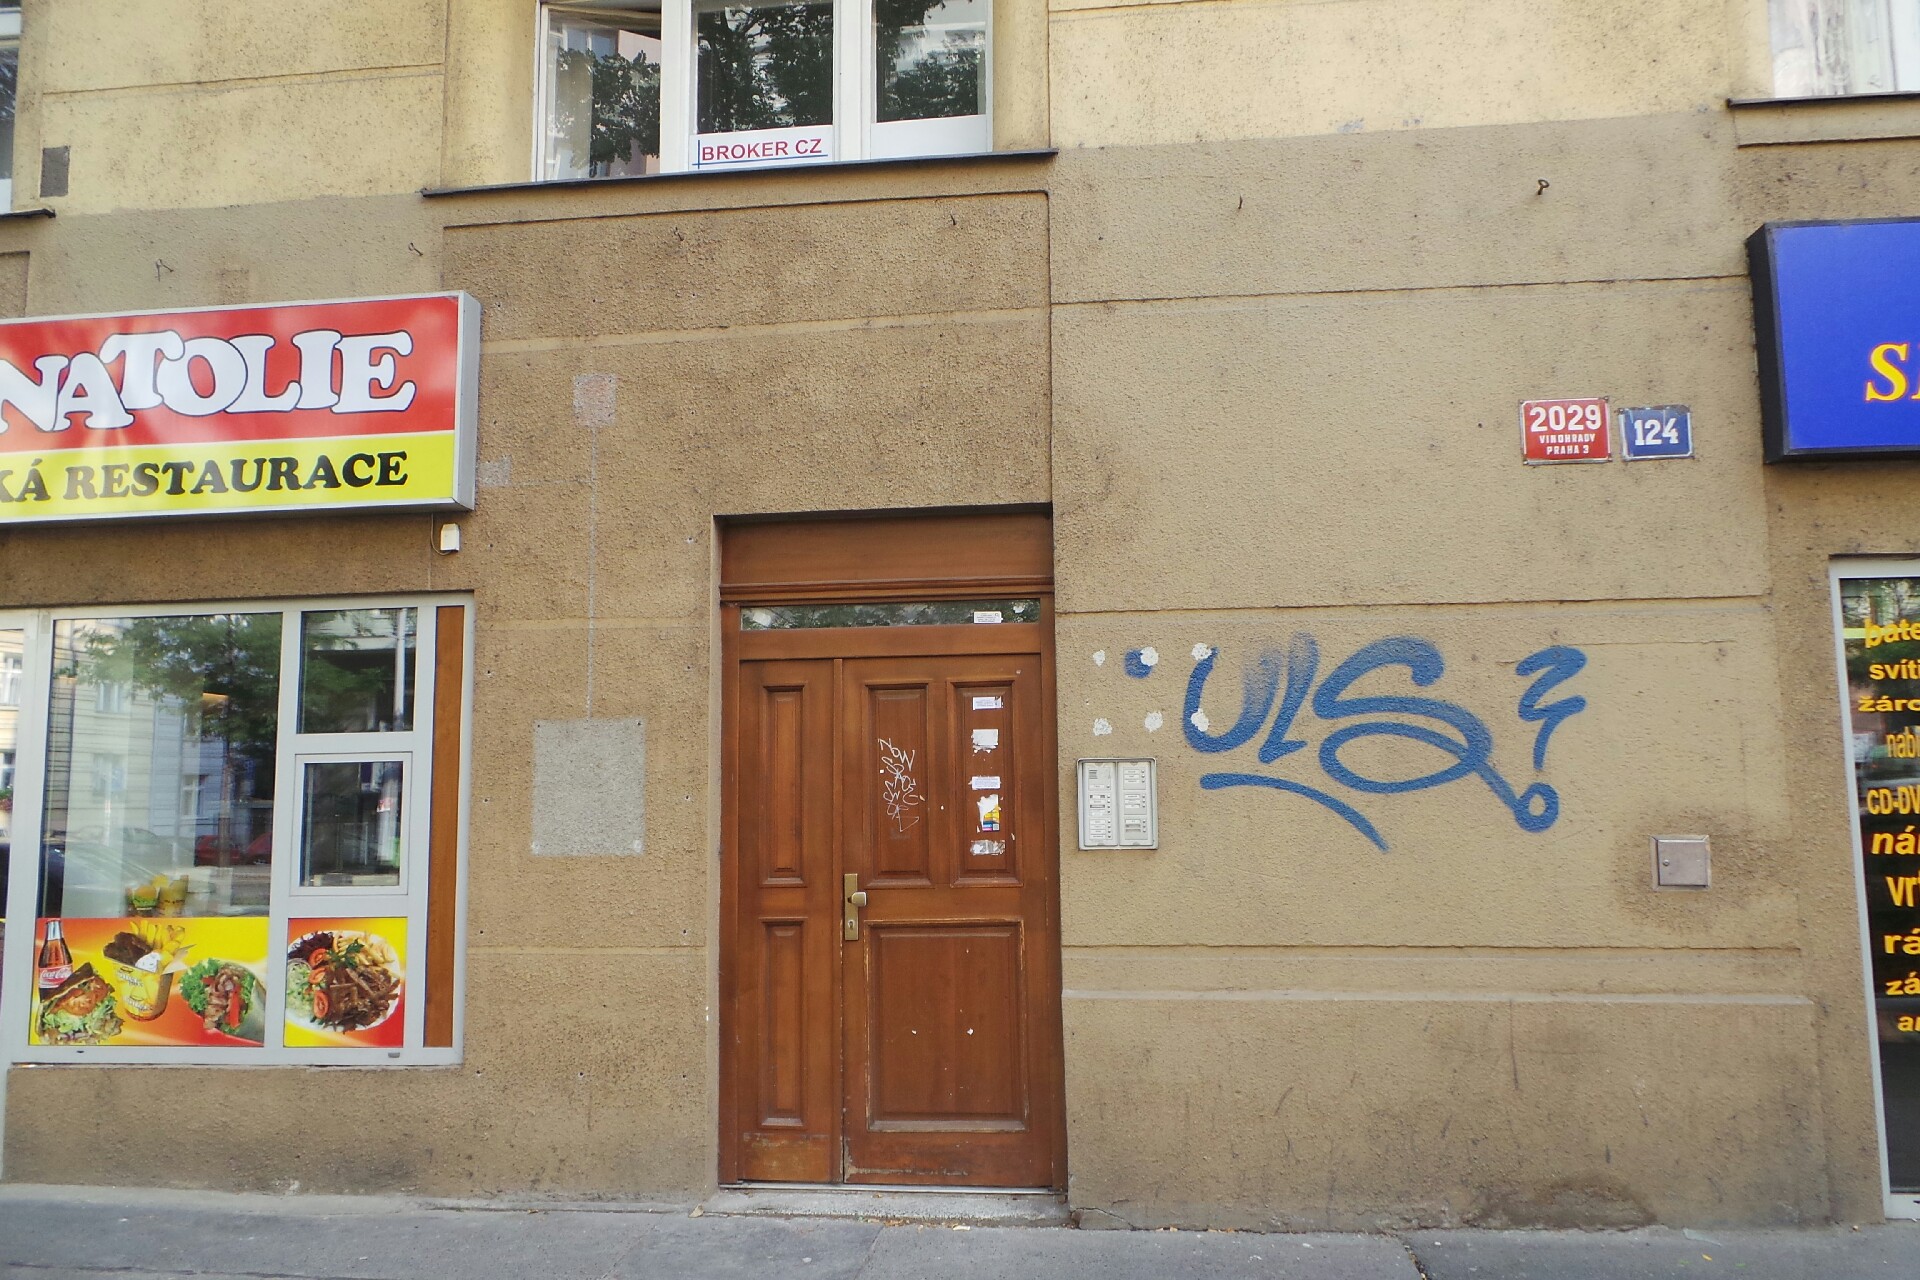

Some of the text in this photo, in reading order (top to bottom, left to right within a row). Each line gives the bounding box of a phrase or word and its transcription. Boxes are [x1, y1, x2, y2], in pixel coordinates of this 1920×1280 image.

[702, 138, 822, 161] BROKER CZ
[0, 329, 416, 432] NATOLIE
[1864, 342, 1920, 401] S
[1529, 404, 1602, 432] 2029
[1634, 417, 1679, 446] 124
[1539, 433, 1596, 444] VINOHRADY
[1546, 444, 1589, 455] PRAHA 3
[62, 450, 408, 500] RESTAURACE
[1871, 825, 1920, 855] ná
